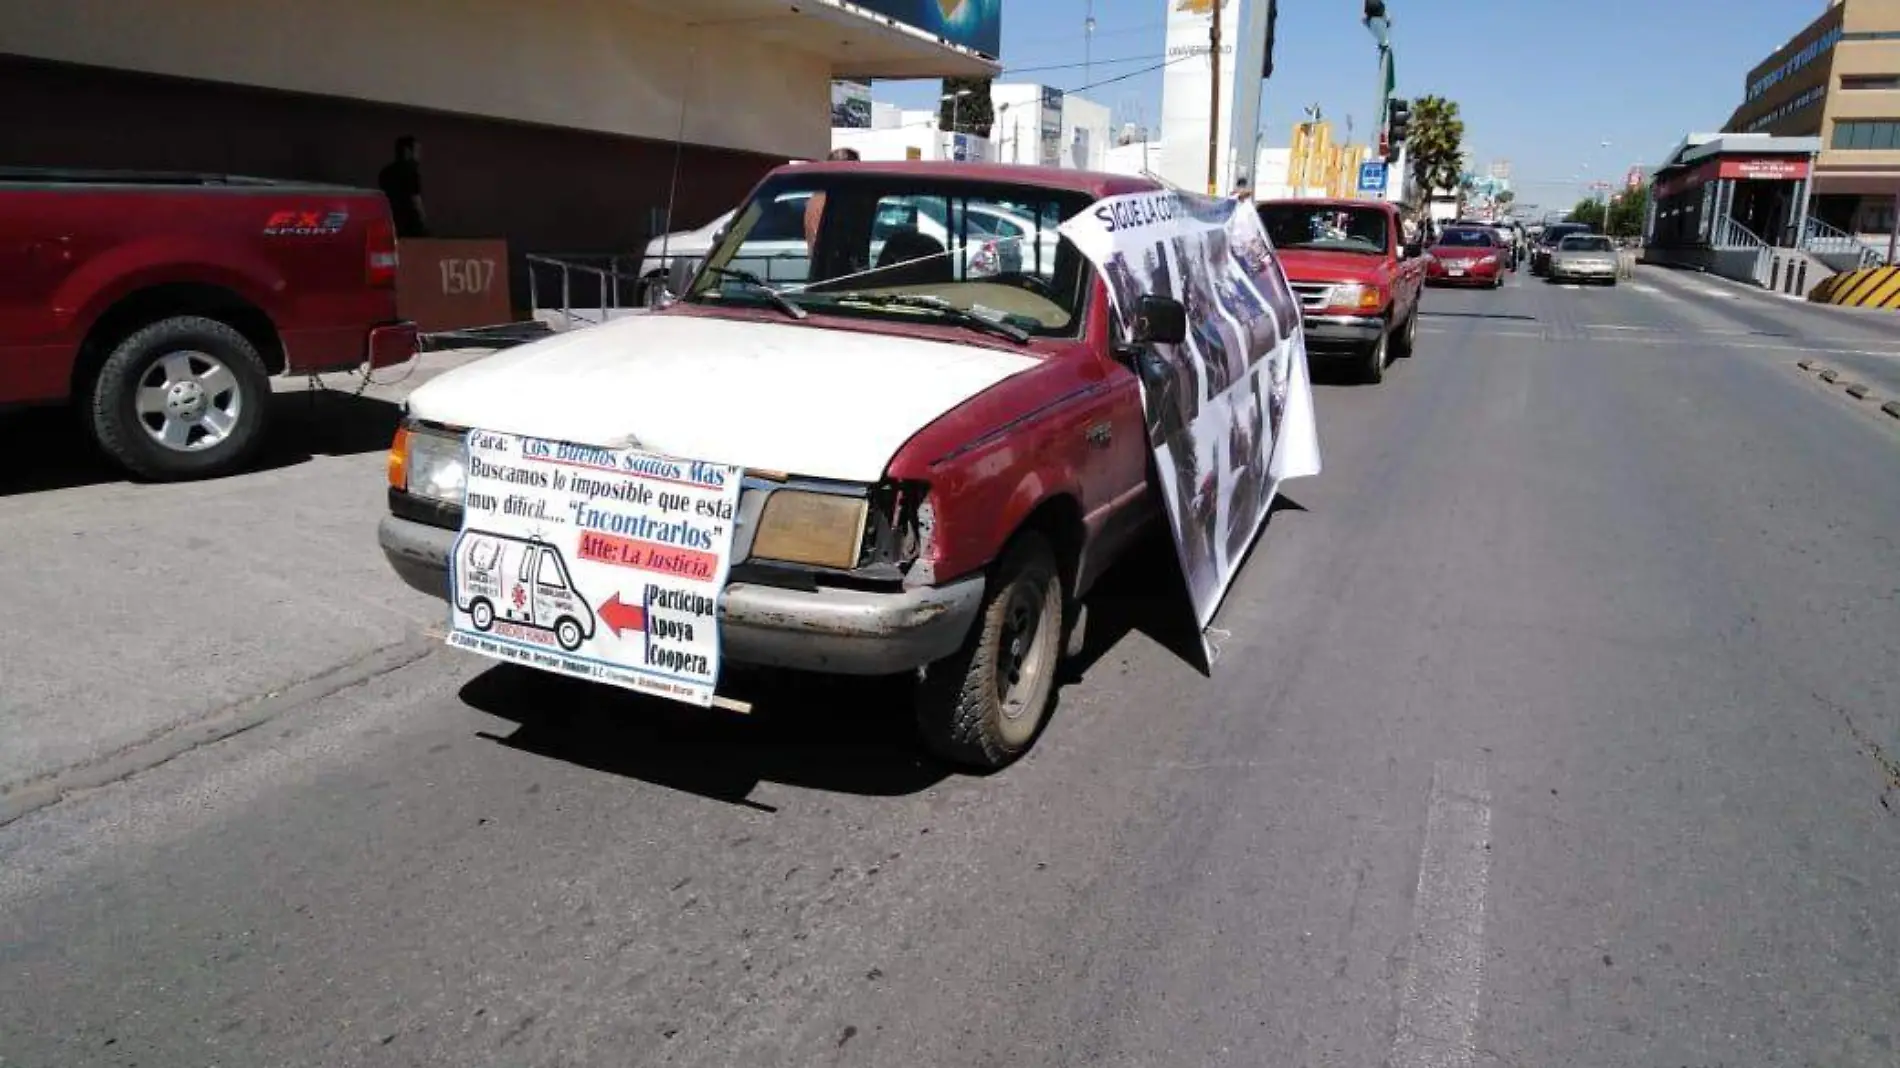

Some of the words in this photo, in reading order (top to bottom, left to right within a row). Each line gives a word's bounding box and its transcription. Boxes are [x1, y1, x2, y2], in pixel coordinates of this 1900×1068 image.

[263, 226, 338, 236] SPORT
[1094, 200, 1143, 232] SIGUE
[439, 258, 496, 296] 1507
[470, 431, 508, 451] Para:
[470, 456, 548, 488] Buscamos
[552, 468, 567, 491] lo
[569, 472, 653, 506] imposible
[658, 492, 690, 514] que
[696, 497, 733, 519] está
[467, 492, 499, 515] muy
[583, 534, 618, 560] Atte:
[621, 544, 641, 565] La
[646, 549, 711, 578] Justicia.
[650, 584, 714, 617] Participa
[650, 615, 694, 642] Apoya
[650, 644, 712, 675] Coopera.
